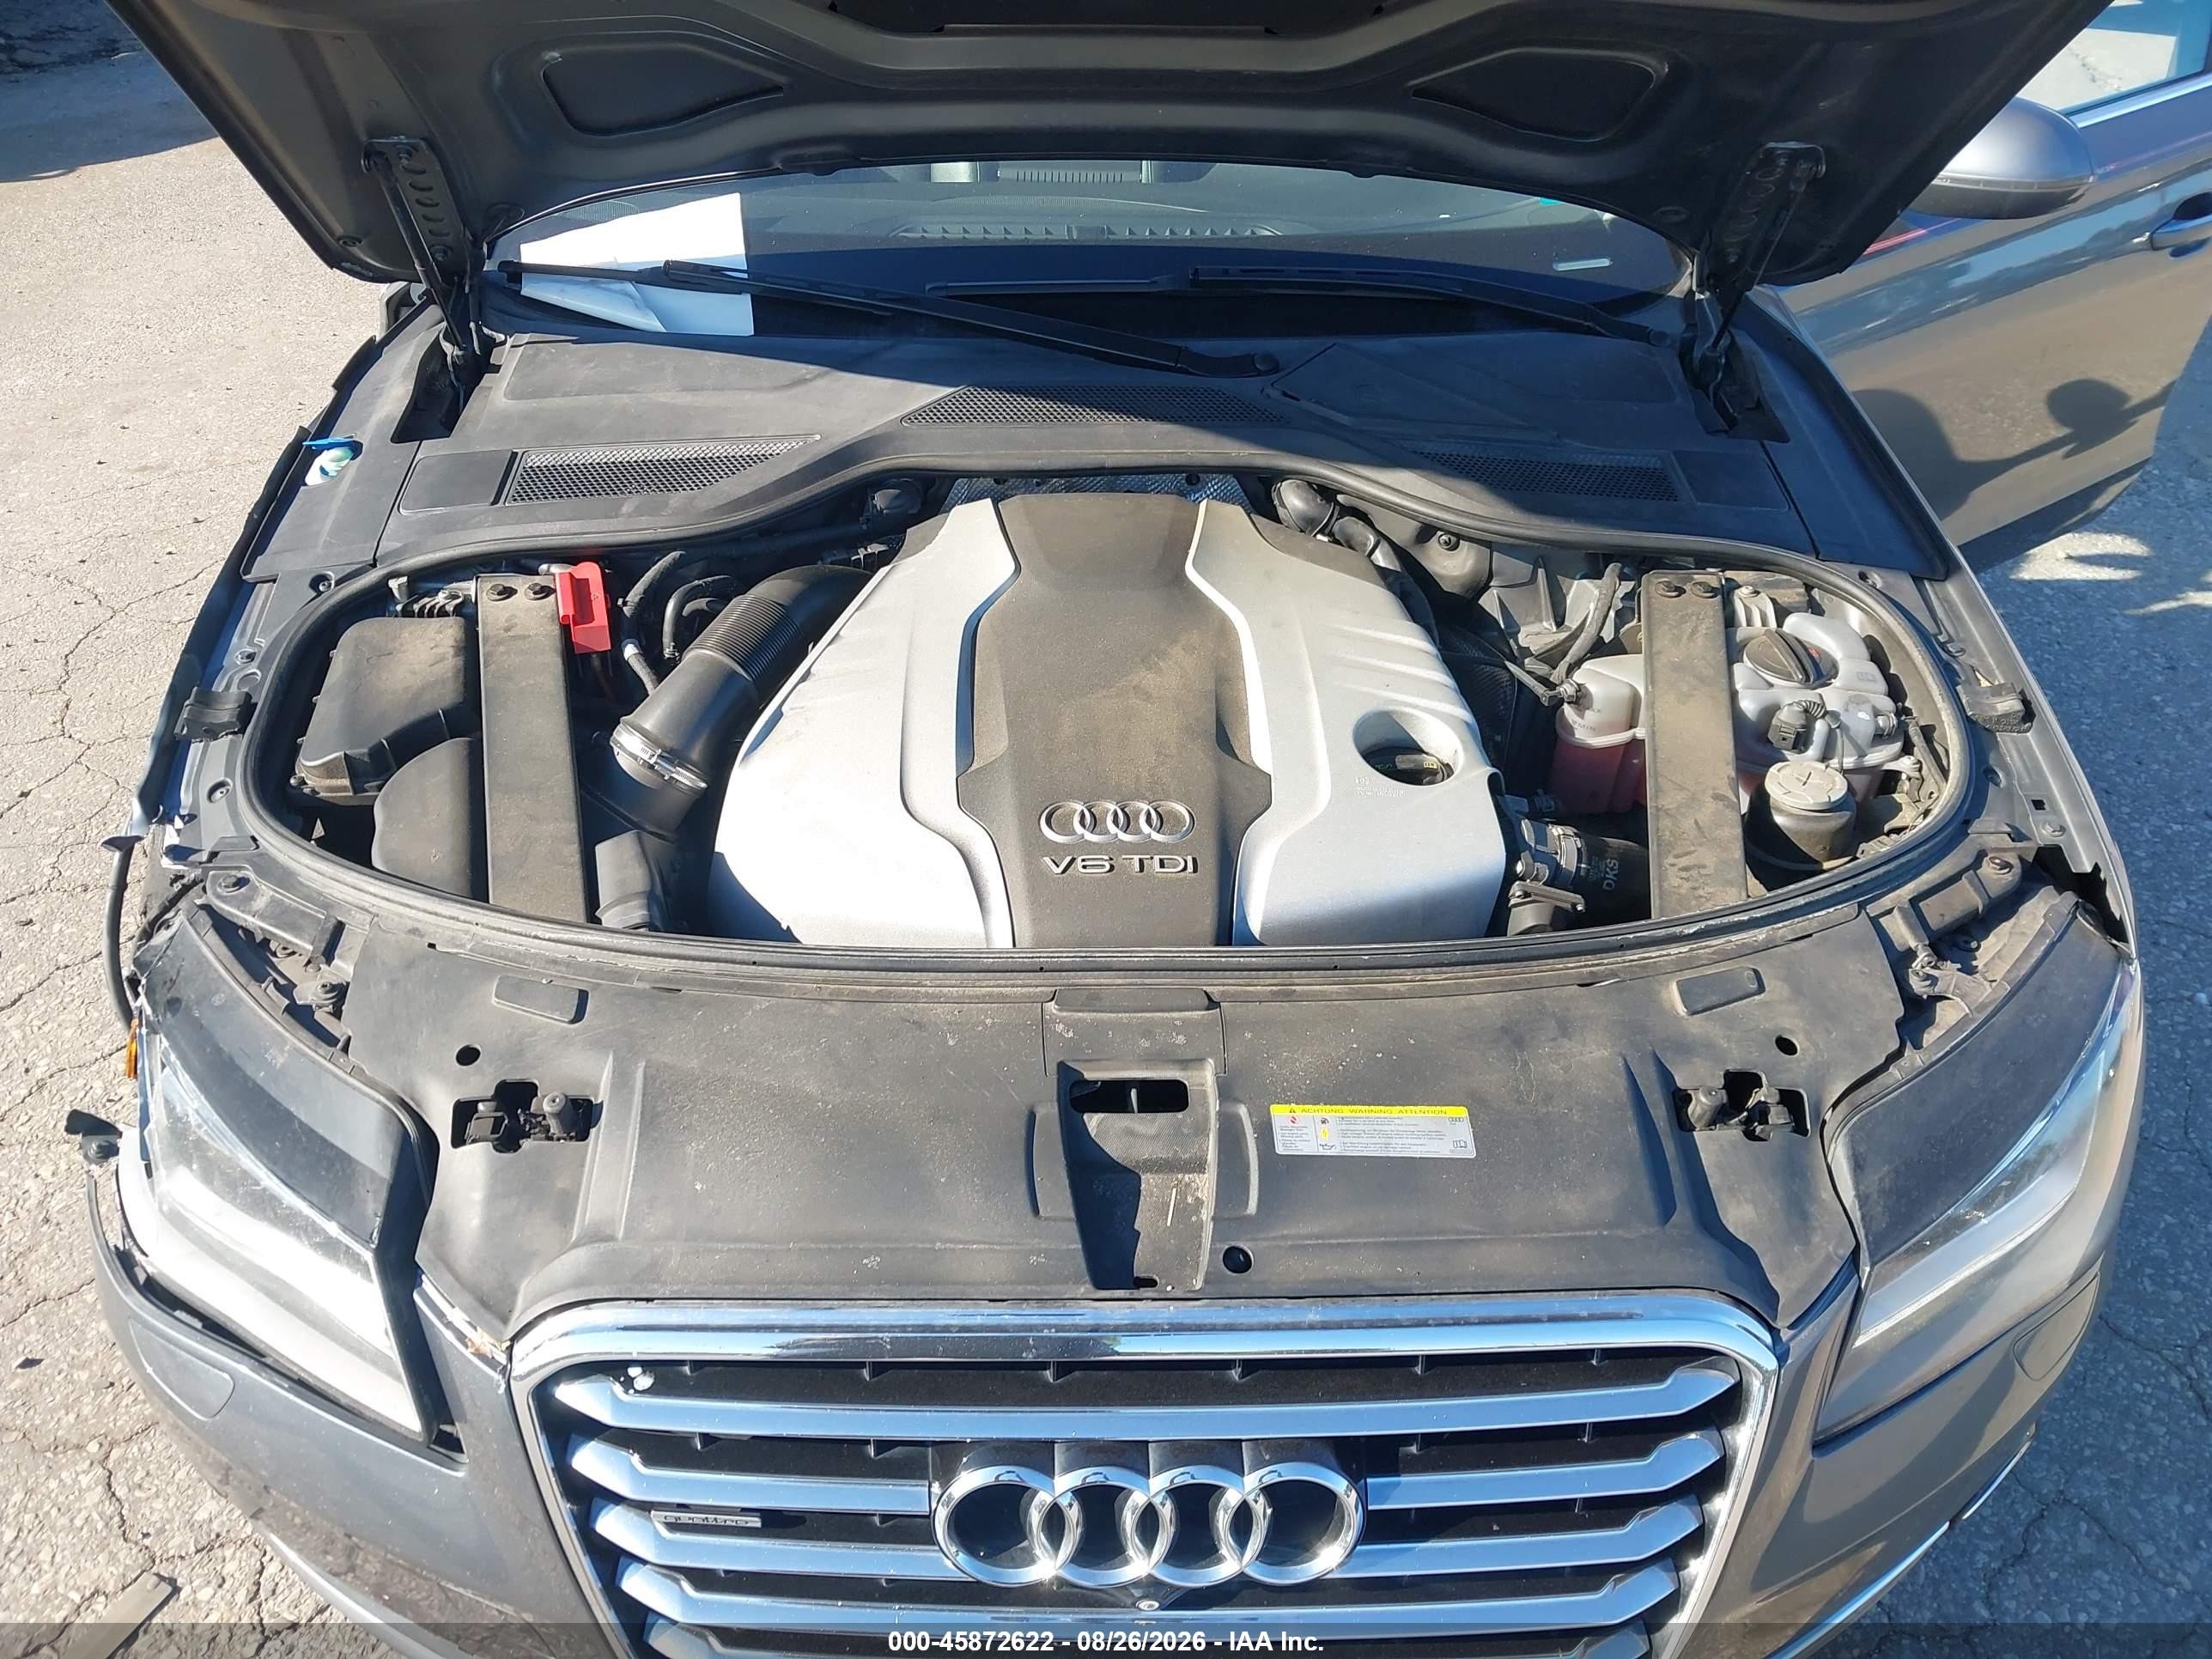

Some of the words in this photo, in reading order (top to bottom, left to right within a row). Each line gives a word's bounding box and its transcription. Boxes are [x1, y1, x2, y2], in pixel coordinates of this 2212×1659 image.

[1042, 854, 1114, 874] V6
[1121, 854, 1195, 874] TDI
[1602, 859, 1619, 890] DKS
[664, 1515, 749, 1526] quattro
